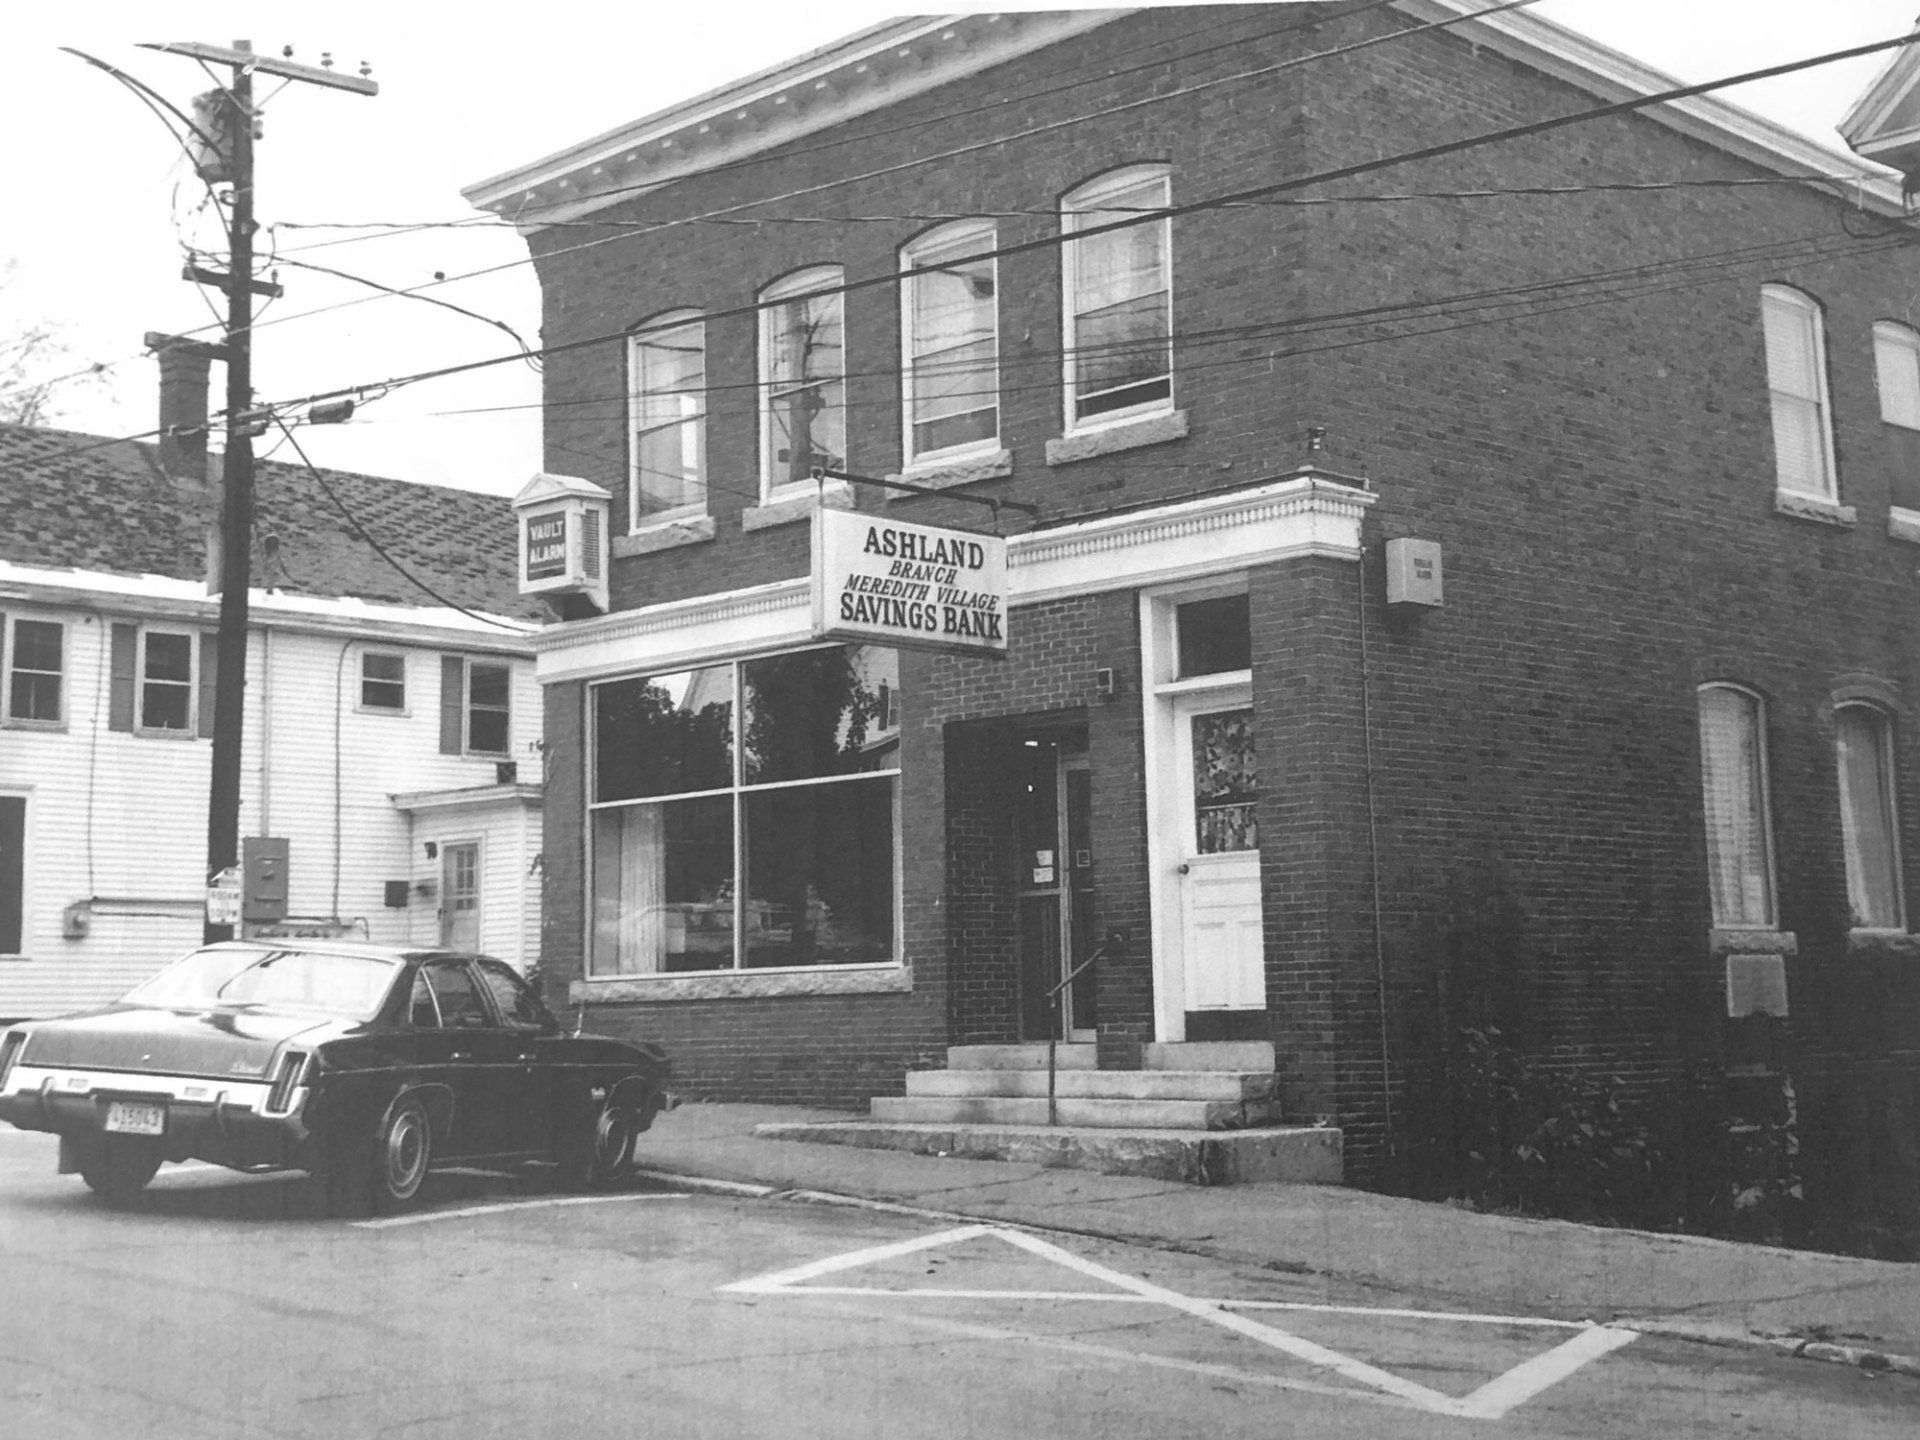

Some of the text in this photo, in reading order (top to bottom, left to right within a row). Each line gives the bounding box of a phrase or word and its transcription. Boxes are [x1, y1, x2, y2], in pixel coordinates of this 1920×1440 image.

[530, 520, 564, 541] VAULT
[530, 543, 566, 564] ALARM
[863, 526, 984, 570] ASHLAND
[888, 560, 958, 585] BRANCH
[843, 573, 1000, 611] MEREDITH VILLAGE
[840, 592, 1003, 639] SAVINGS BANK
